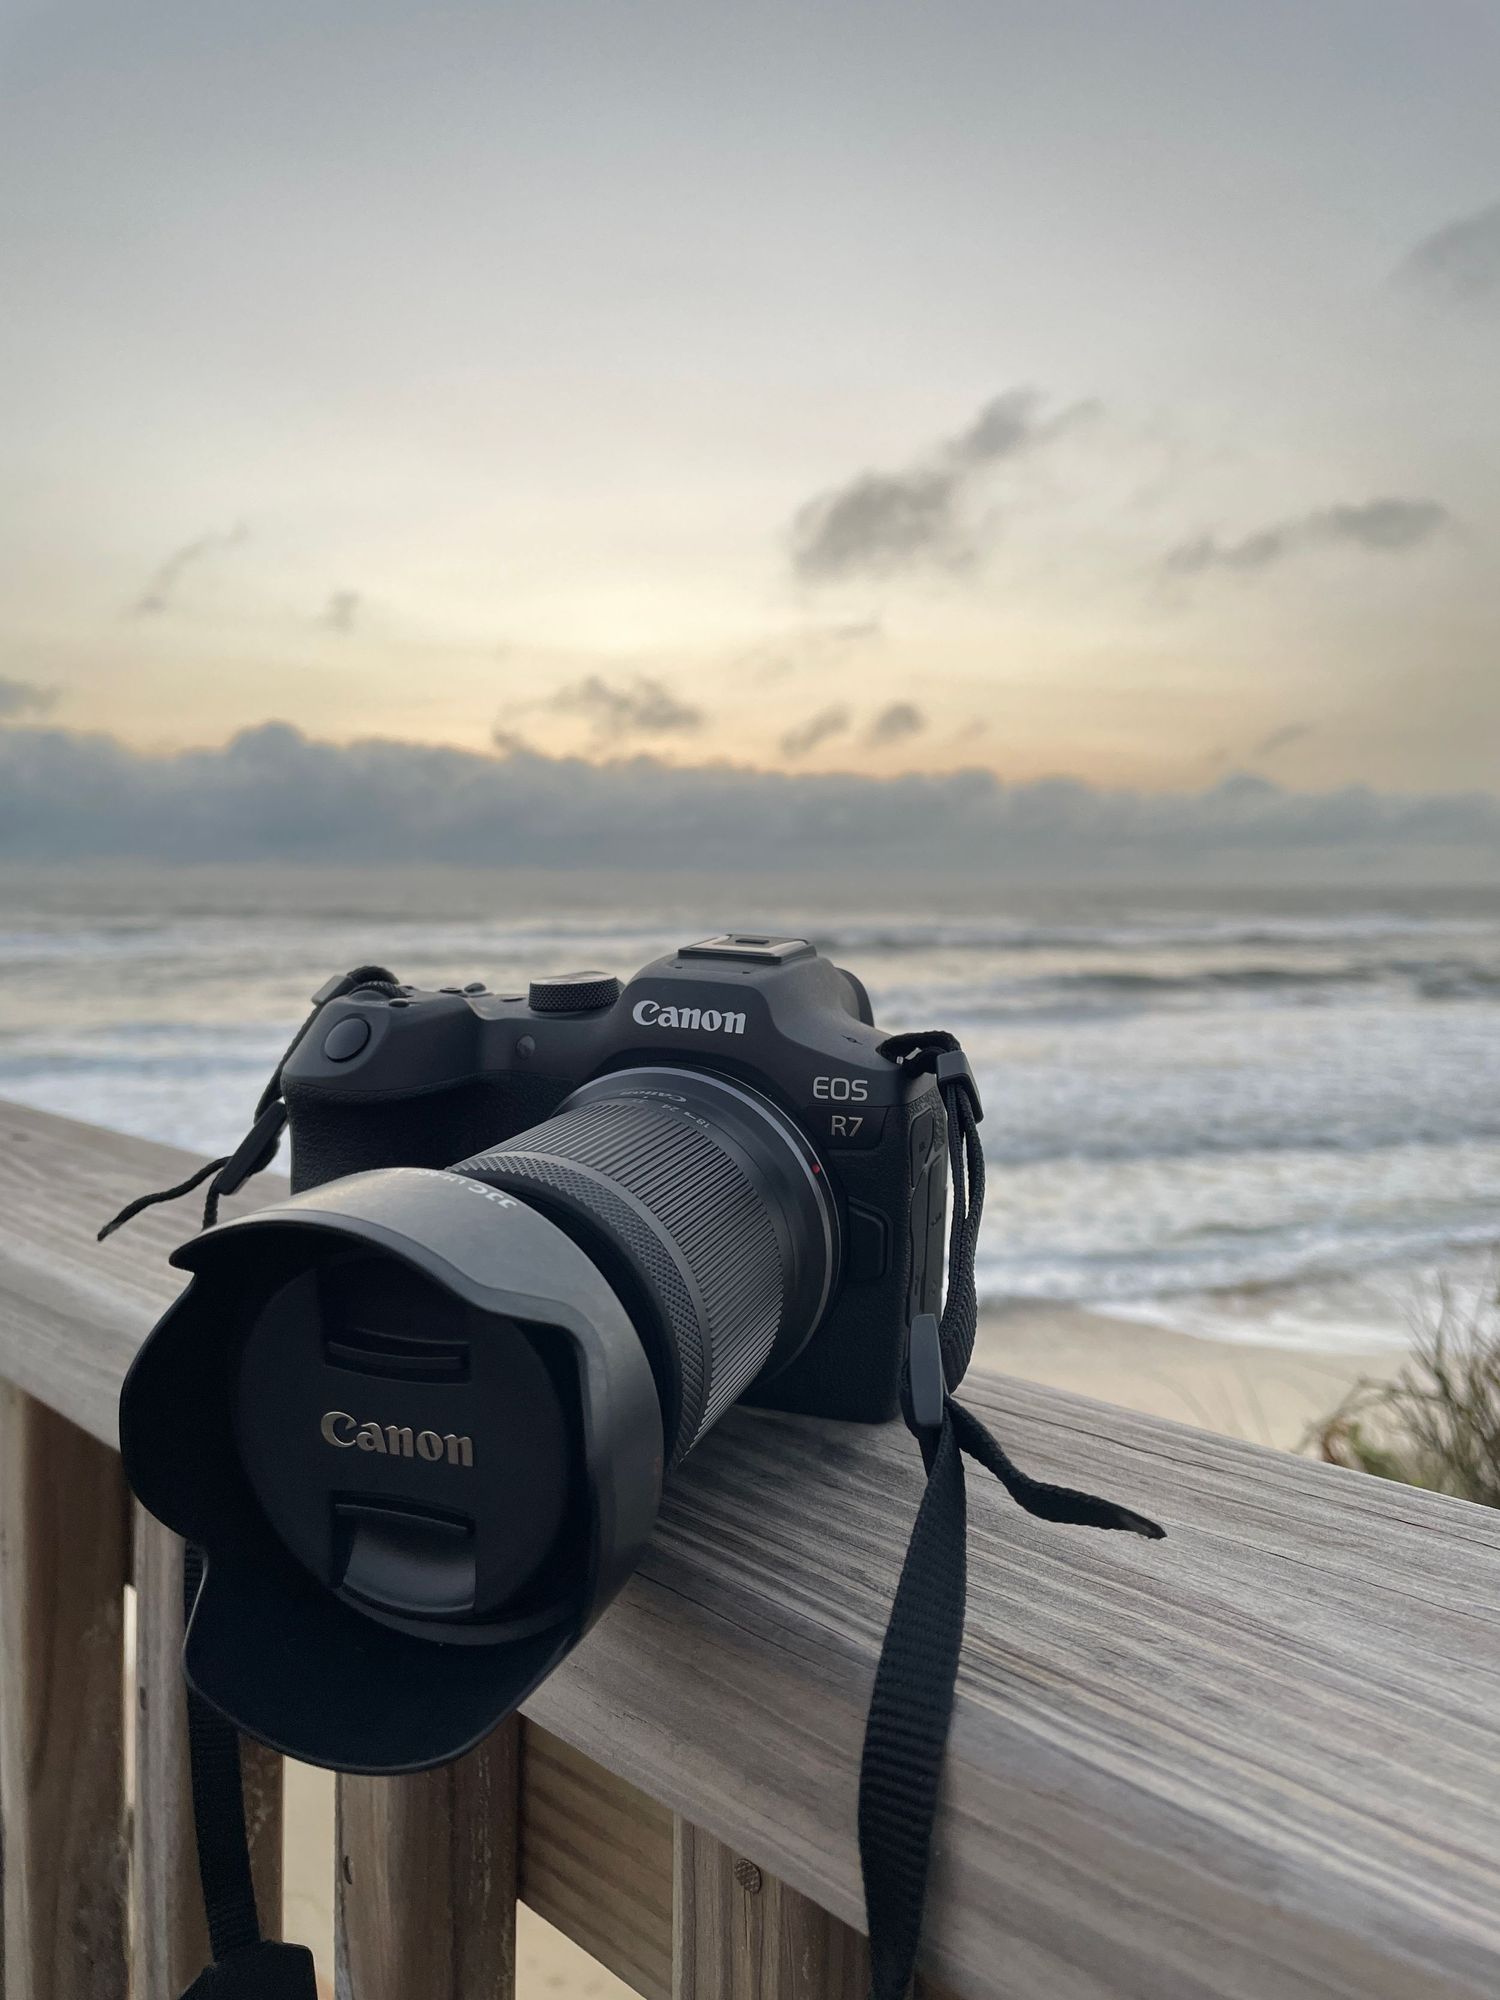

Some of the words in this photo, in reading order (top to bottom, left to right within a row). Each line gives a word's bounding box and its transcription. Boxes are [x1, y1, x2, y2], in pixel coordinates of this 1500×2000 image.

[633, 1000, 746, 1034] Canon
[813, 1076, 869, 1101] EOS
[831, 1115, 863, 1137] R7
[320, 1411, 474, 1467] Canon
